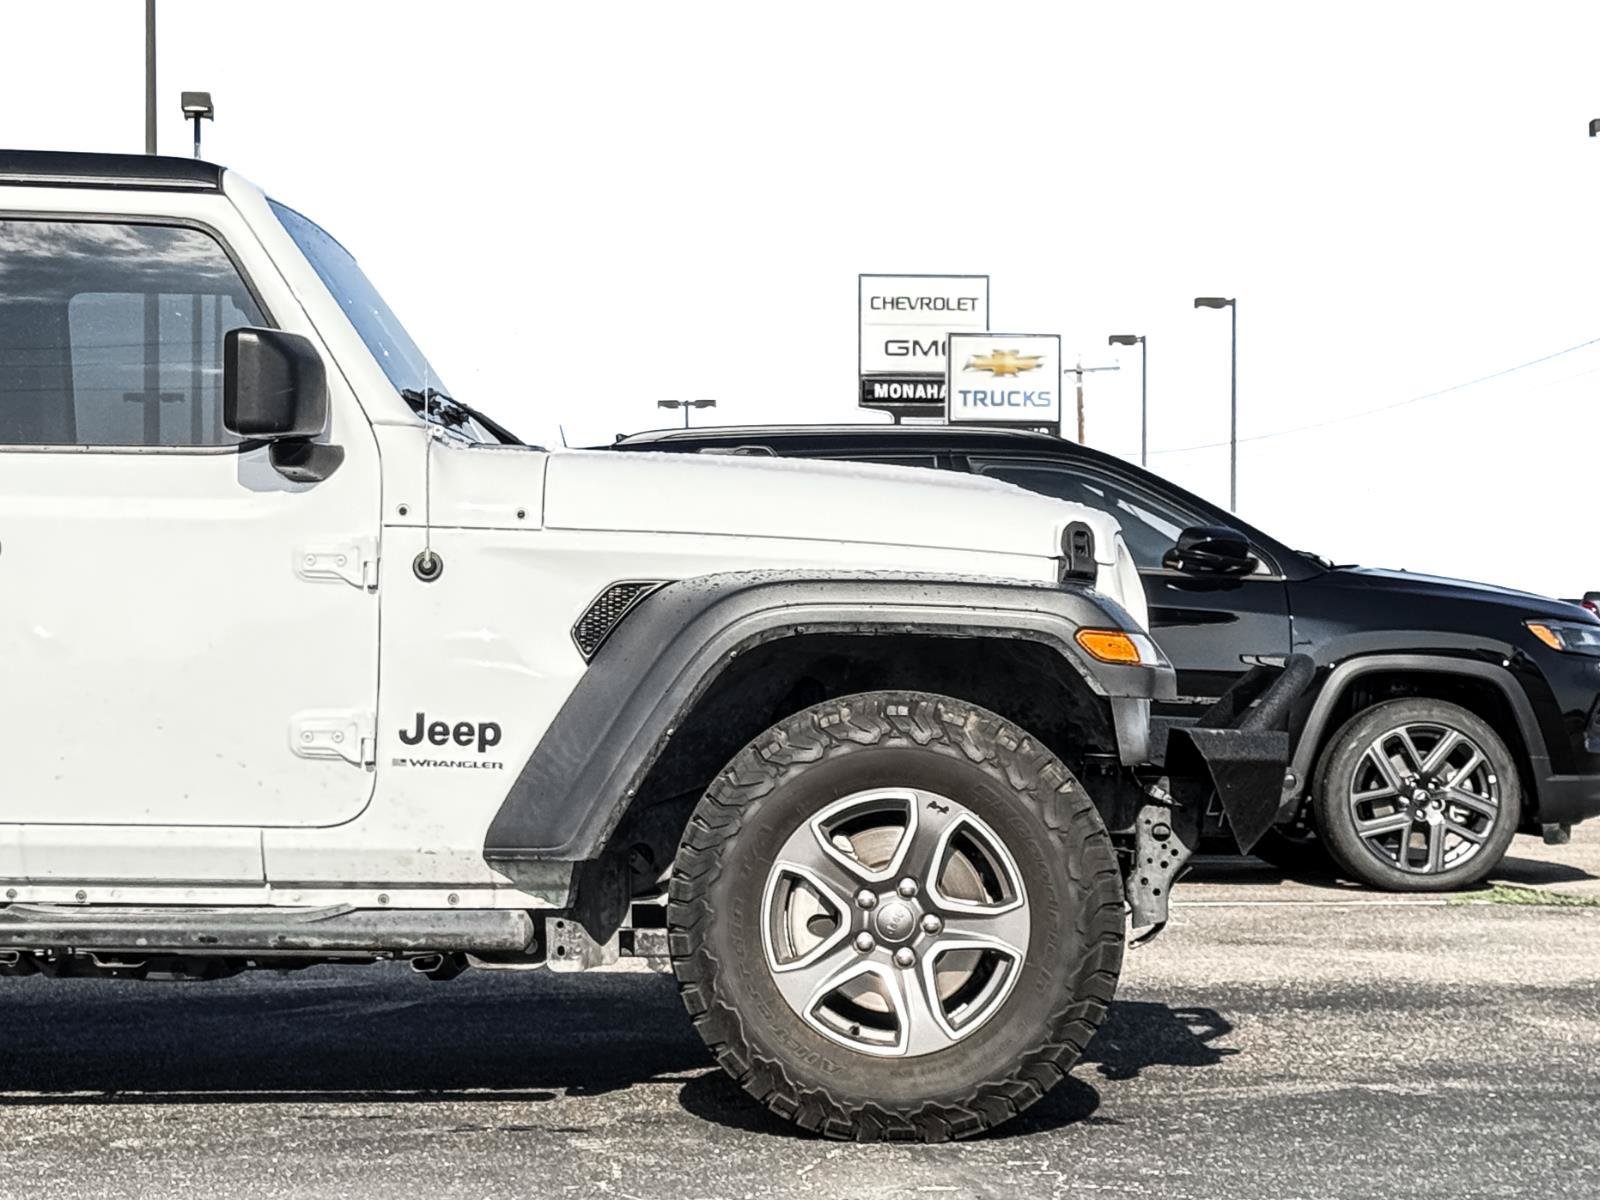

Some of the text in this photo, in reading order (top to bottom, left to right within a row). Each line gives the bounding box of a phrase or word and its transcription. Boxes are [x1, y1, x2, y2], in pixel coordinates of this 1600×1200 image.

[870, 296, 979, 311] CHEVROLET
[884, 339, 946, 357] GM
[958, 390, 1052, 407] TRUCKS
[398, 711, 502, 753] Jeep
[409, 758, 504, 770] WRANGLER
